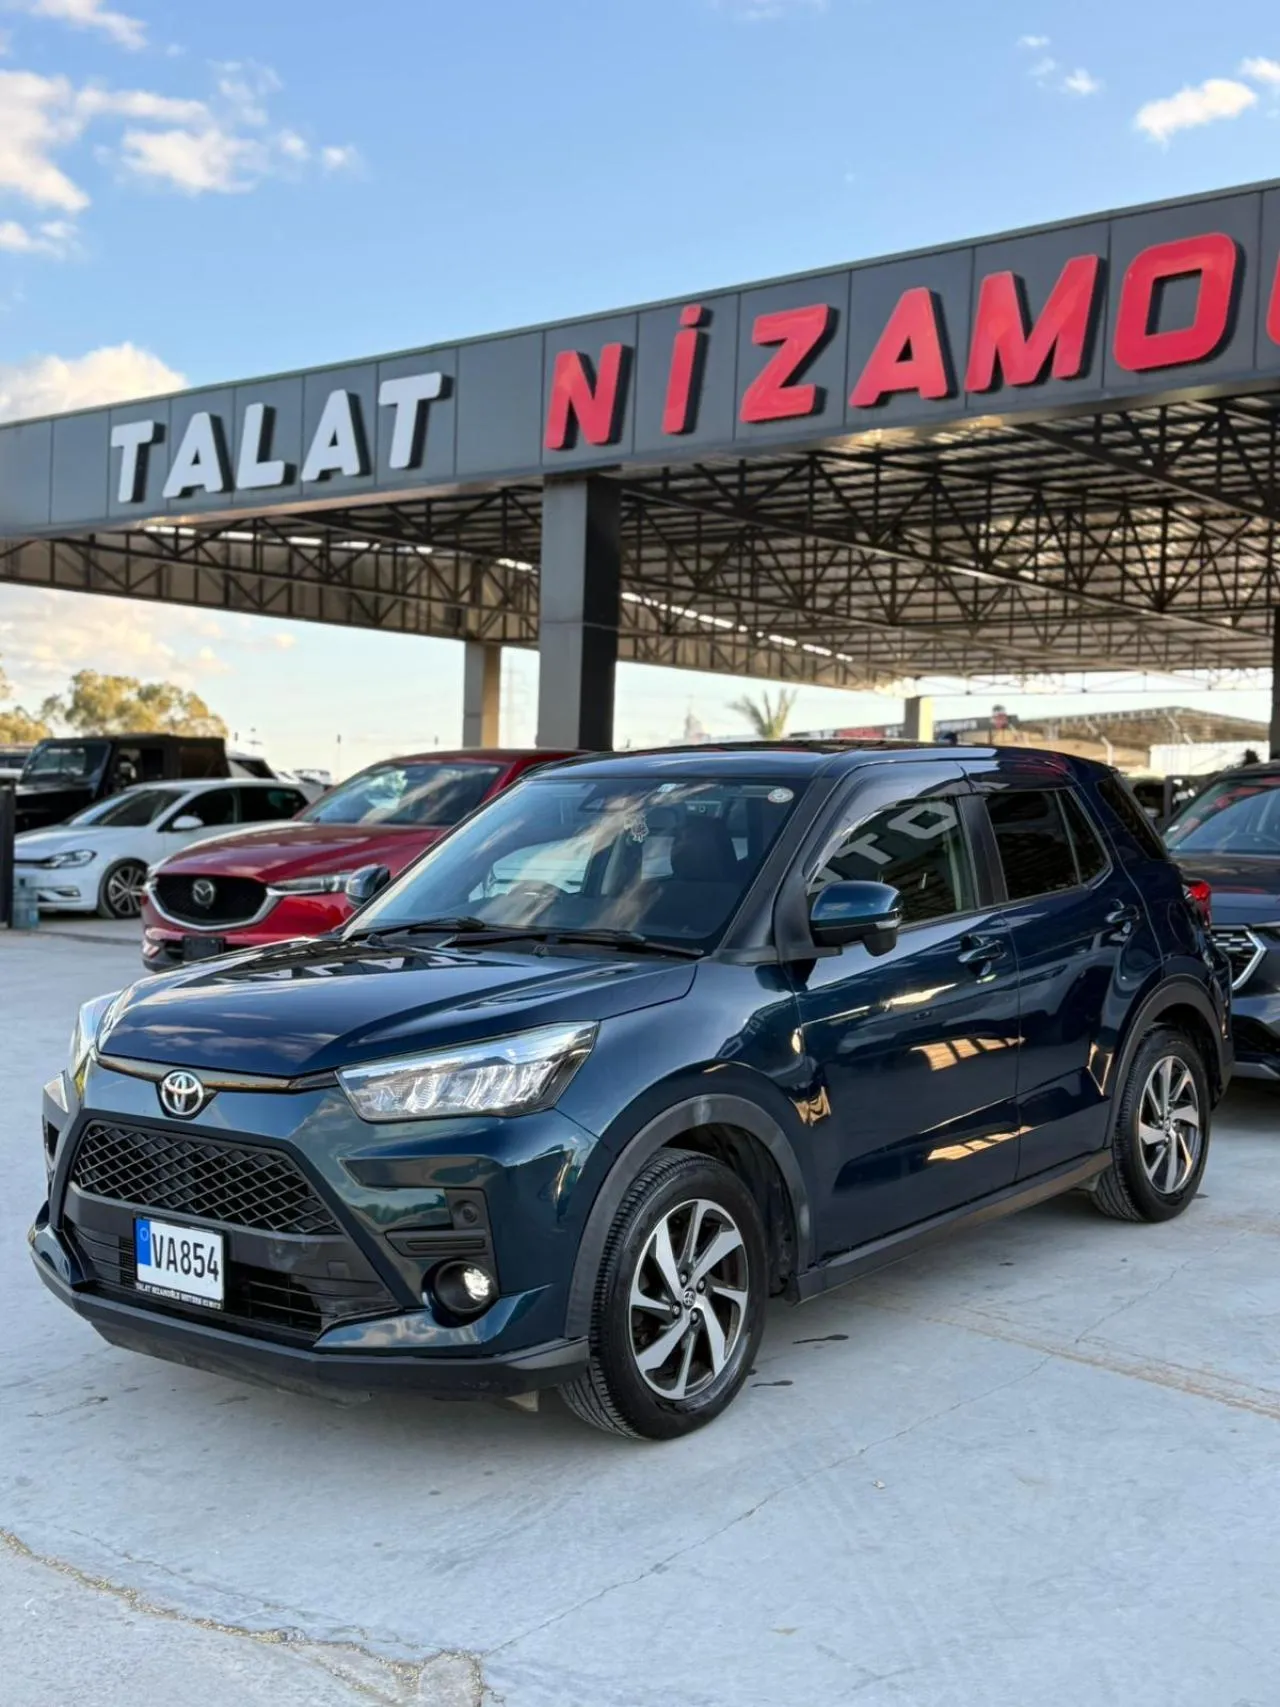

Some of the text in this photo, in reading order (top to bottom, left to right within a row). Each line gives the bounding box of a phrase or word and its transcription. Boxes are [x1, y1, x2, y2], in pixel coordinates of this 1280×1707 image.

[110, 231, 1280, 503] TALAT NİZAMO
[151, 1232, 220, 1283] VA854
